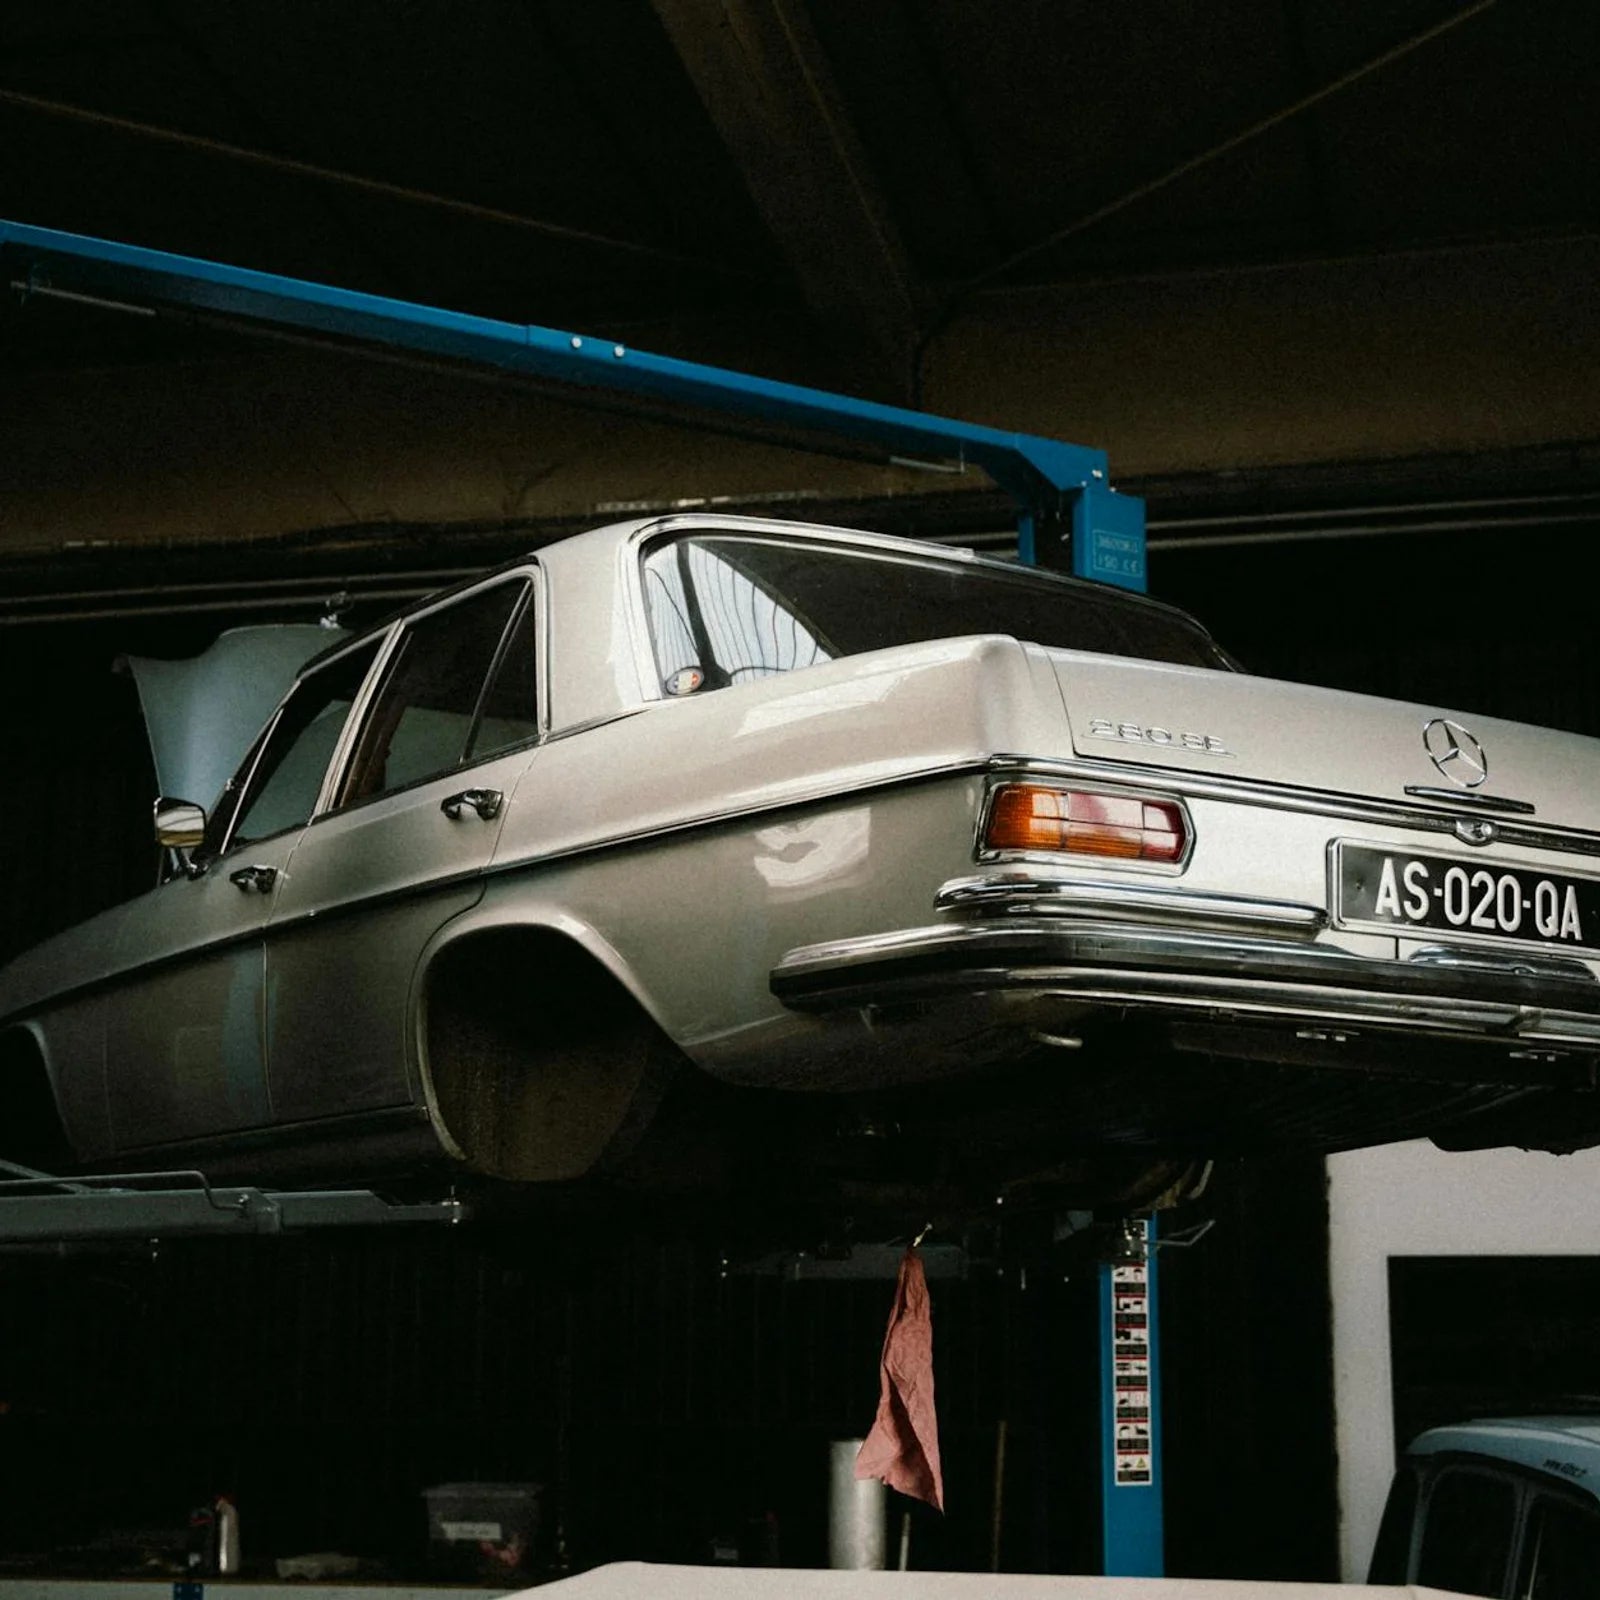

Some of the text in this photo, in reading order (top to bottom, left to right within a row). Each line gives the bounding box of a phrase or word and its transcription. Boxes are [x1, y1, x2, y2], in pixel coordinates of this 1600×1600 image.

[1090, 718, 1225, 753] 280 SE
[1375, 858, 1582, 940] AS-020-QA
